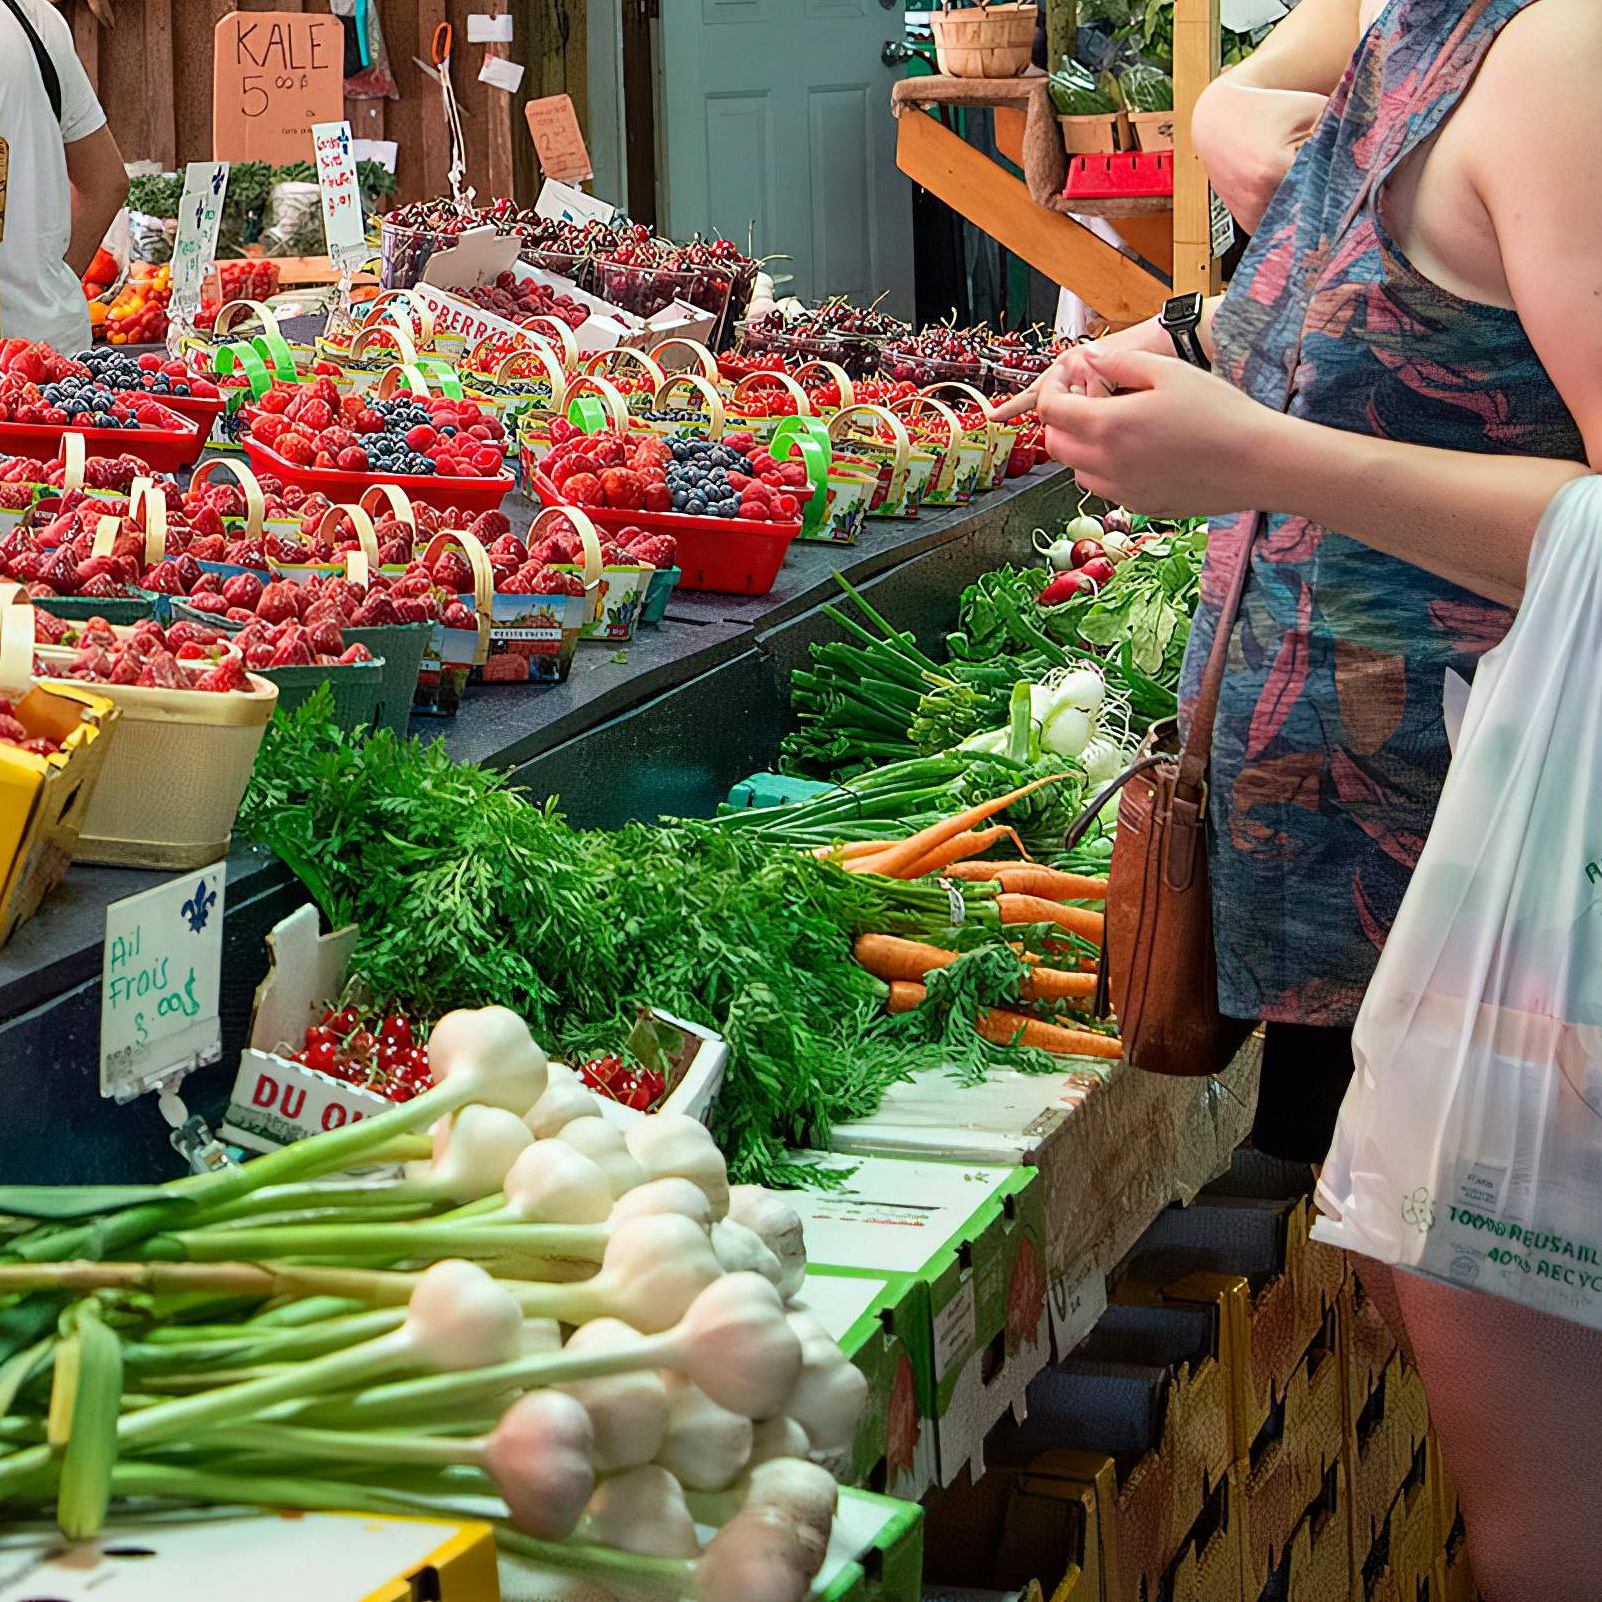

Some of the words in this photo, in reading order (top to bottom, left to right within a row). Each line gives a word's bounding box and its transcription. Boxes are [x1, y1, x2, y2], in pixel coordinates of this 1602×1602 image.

[237, 19, 329, 71] KALE
[111, 925, 140, 973] Ail
[252, 1073, 307, 1119] DU
